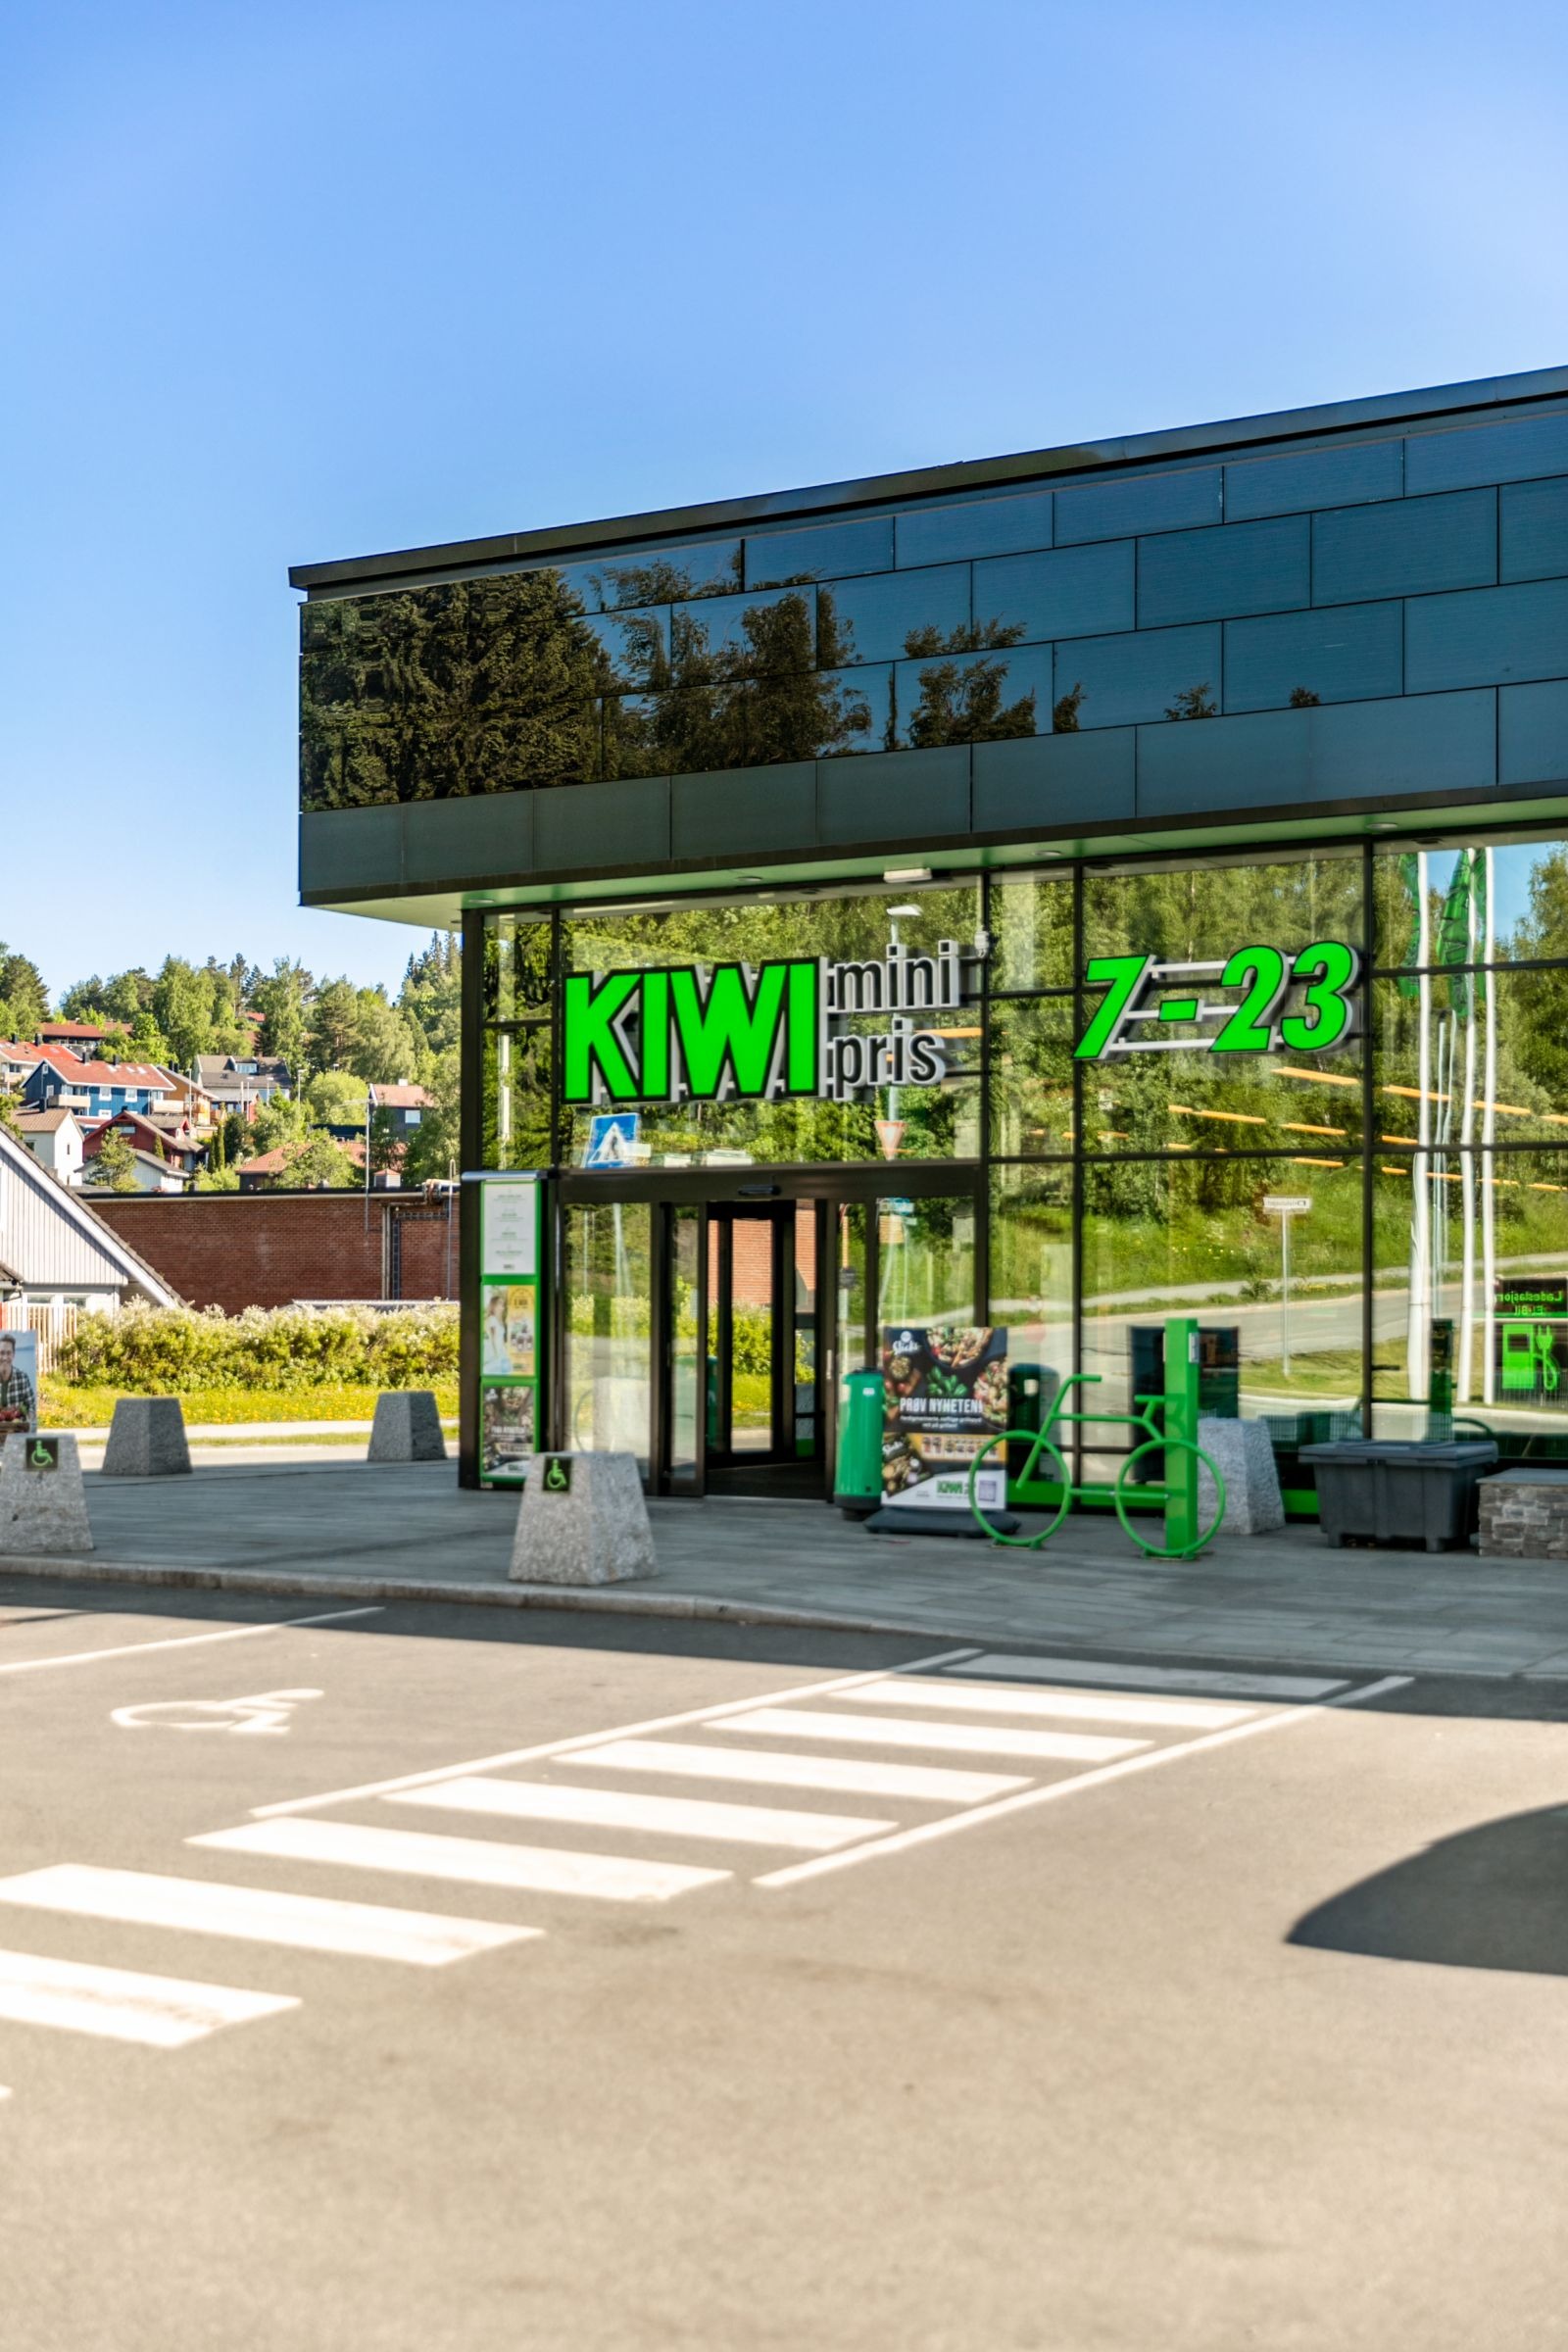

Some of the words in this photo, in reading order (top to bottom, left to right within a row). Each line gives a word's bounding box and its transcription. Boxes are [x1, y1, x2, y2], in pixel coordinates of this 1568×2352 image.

[834, 941, 957, 1010] mini
[563, 956, 821, 1104] KIWI
[833, 1017, 945, 1101] pris
